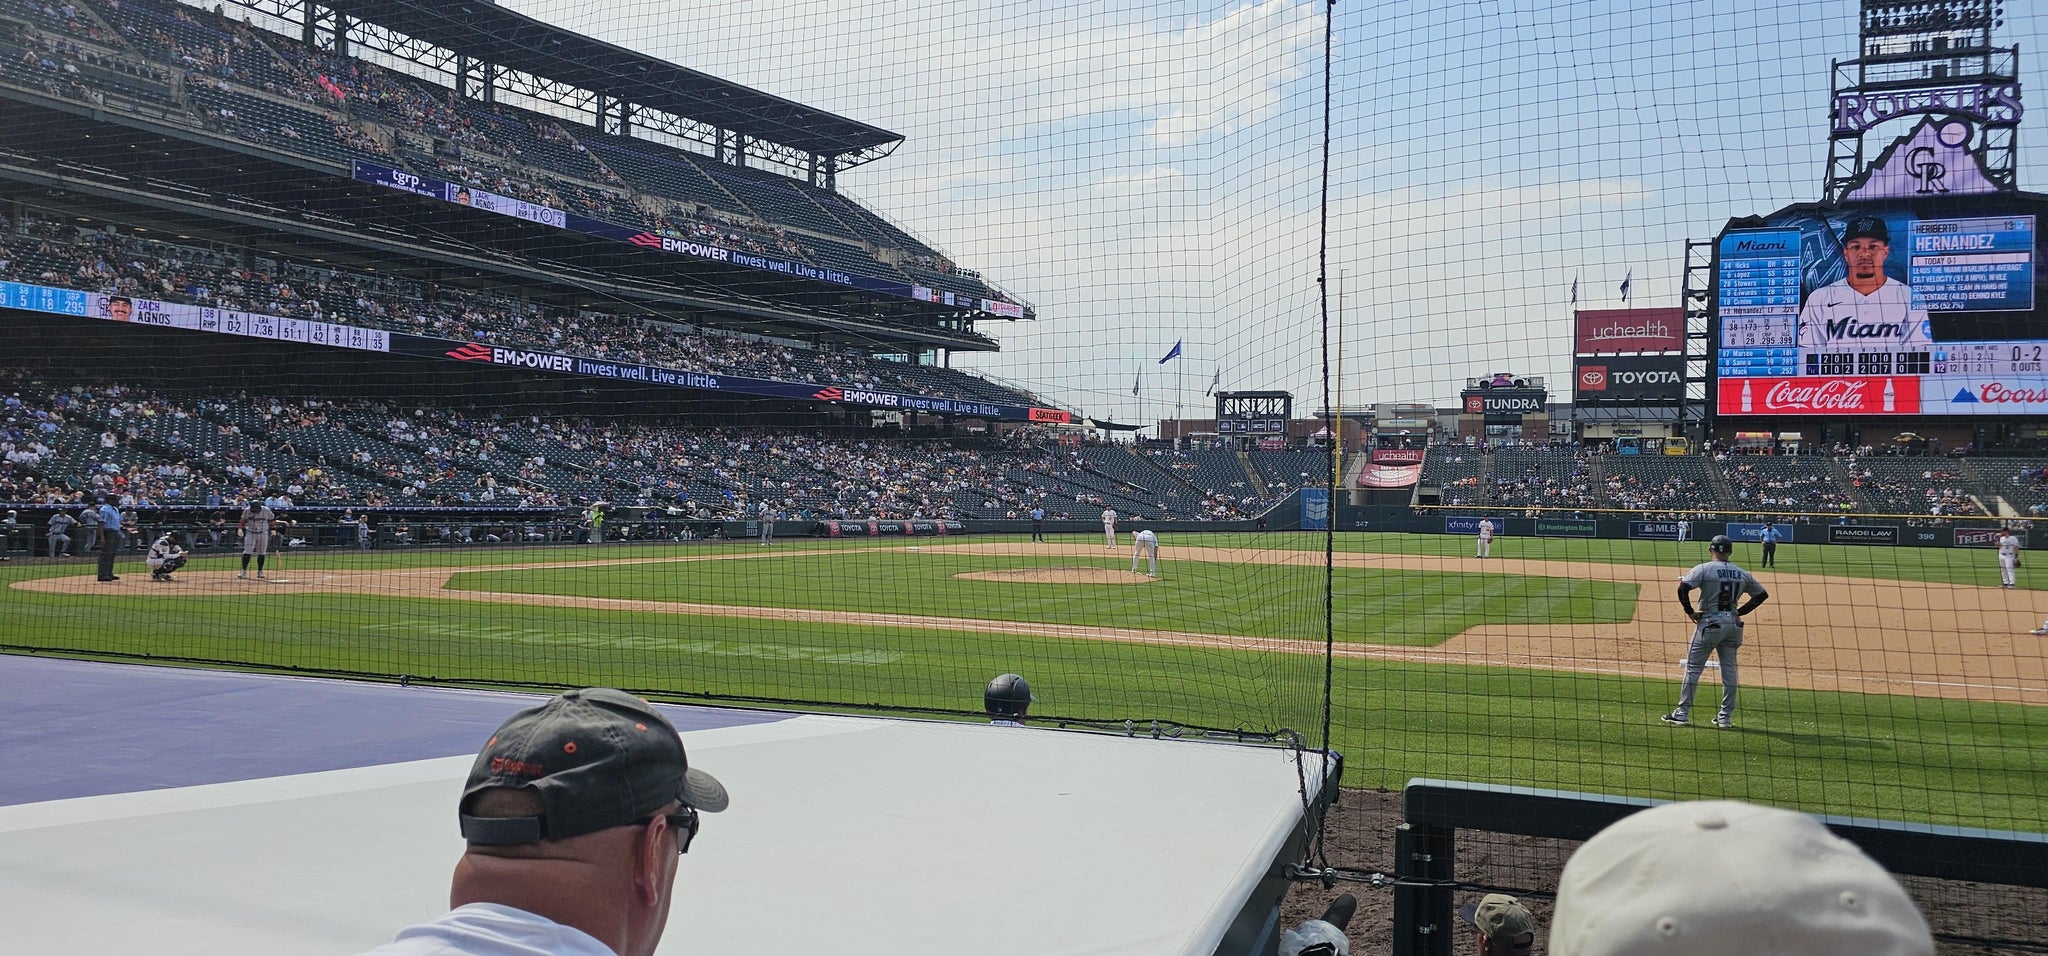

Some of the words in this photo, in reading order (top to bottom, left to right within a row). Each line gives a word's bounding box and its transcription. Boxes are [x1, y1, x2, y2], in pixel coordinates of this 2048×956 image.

[1832, 83, 2024, 132] ROCKIES
[392, 169, 420, 188] tgrp
[475, 200, 494, 210] AGNOS
[558, 217, 562, 226] 2
[1916, 224, 1957, 233] HERIBERTO
[2004, 222, 2013, 230] 13
[1737, 240, 1786, 252] Miami
[1916, 234, 1995, 252] HERNANDEZ
[662, 238, 727, 261] EMPOWER
[733, 252, 767, 269] Invest
[768, 260, 793, 274] well.
[796, 263, 816, 278] Live
[818, 270, 824, 280] a
[827, 270, 852, 285] little.
[19, 286, 29, 294] SB
[42, 288, 52, 297] BB
[66, 290, 80, 300] OBP
[21, 296, 26, 306] 5
[42, 298, 53, 310] 18
[138, 300, 160, 311] ZACH
[62, 301, 84, 314] .295
[138, 313, 171, 325] AGNOS
[203, 320, 216, 329] RHP
[259, 316, 269, 324] ERA
[227, 321, 241, 332] 0-2
[254, 324, 273, 336] 7.36
[1594, 321, 1668, 338] uchealth
[284, 328, 302, 340] 51.1
[313, 331, 324, 342] 42
[335, 333, 339, 344] 8
[352, 336, 362, 347] 23
[373, 338, 382, 349] 35
[2013, 346, 2020, 361] 0
[2033, 346, 2041, 361] 2
[494, 349, 572, 372] EMPOWER
[578, 359, 617, 377] Invest
[620, 365, 648, 381] well.
[651, 369, 675, 384] Live
[678, 376, 684, 385] a
[687, 373, 719, 389] little.
[2011, 363, 2016, 371] 0
[2019, 362, 2041, 371] OUTS
[1613, 372, 1680, 384] TOYOTA
[1766, 380, 1867, 410] Coca-Cola
[1980, 383, 2048, 403] Coors
[844, 390, 898, 406] EMPOWER
[902, 396, 929, 409] Invest
[931, 399, 952, 411] well.
[954, 402, 971, 413] Live
[980, 403, 1000, 416] little.
[1484, 399, 1539, 409] TUNDRA
[1035, 410, 1064, 421] SEATGEEK
[1379, 450, 1418, 460] uchealth
[1448, 518, 1473, 529] xfinity
[1656, 524, 1676, 533] MLB
[1717, 570, 1741, 579] DRIVER
